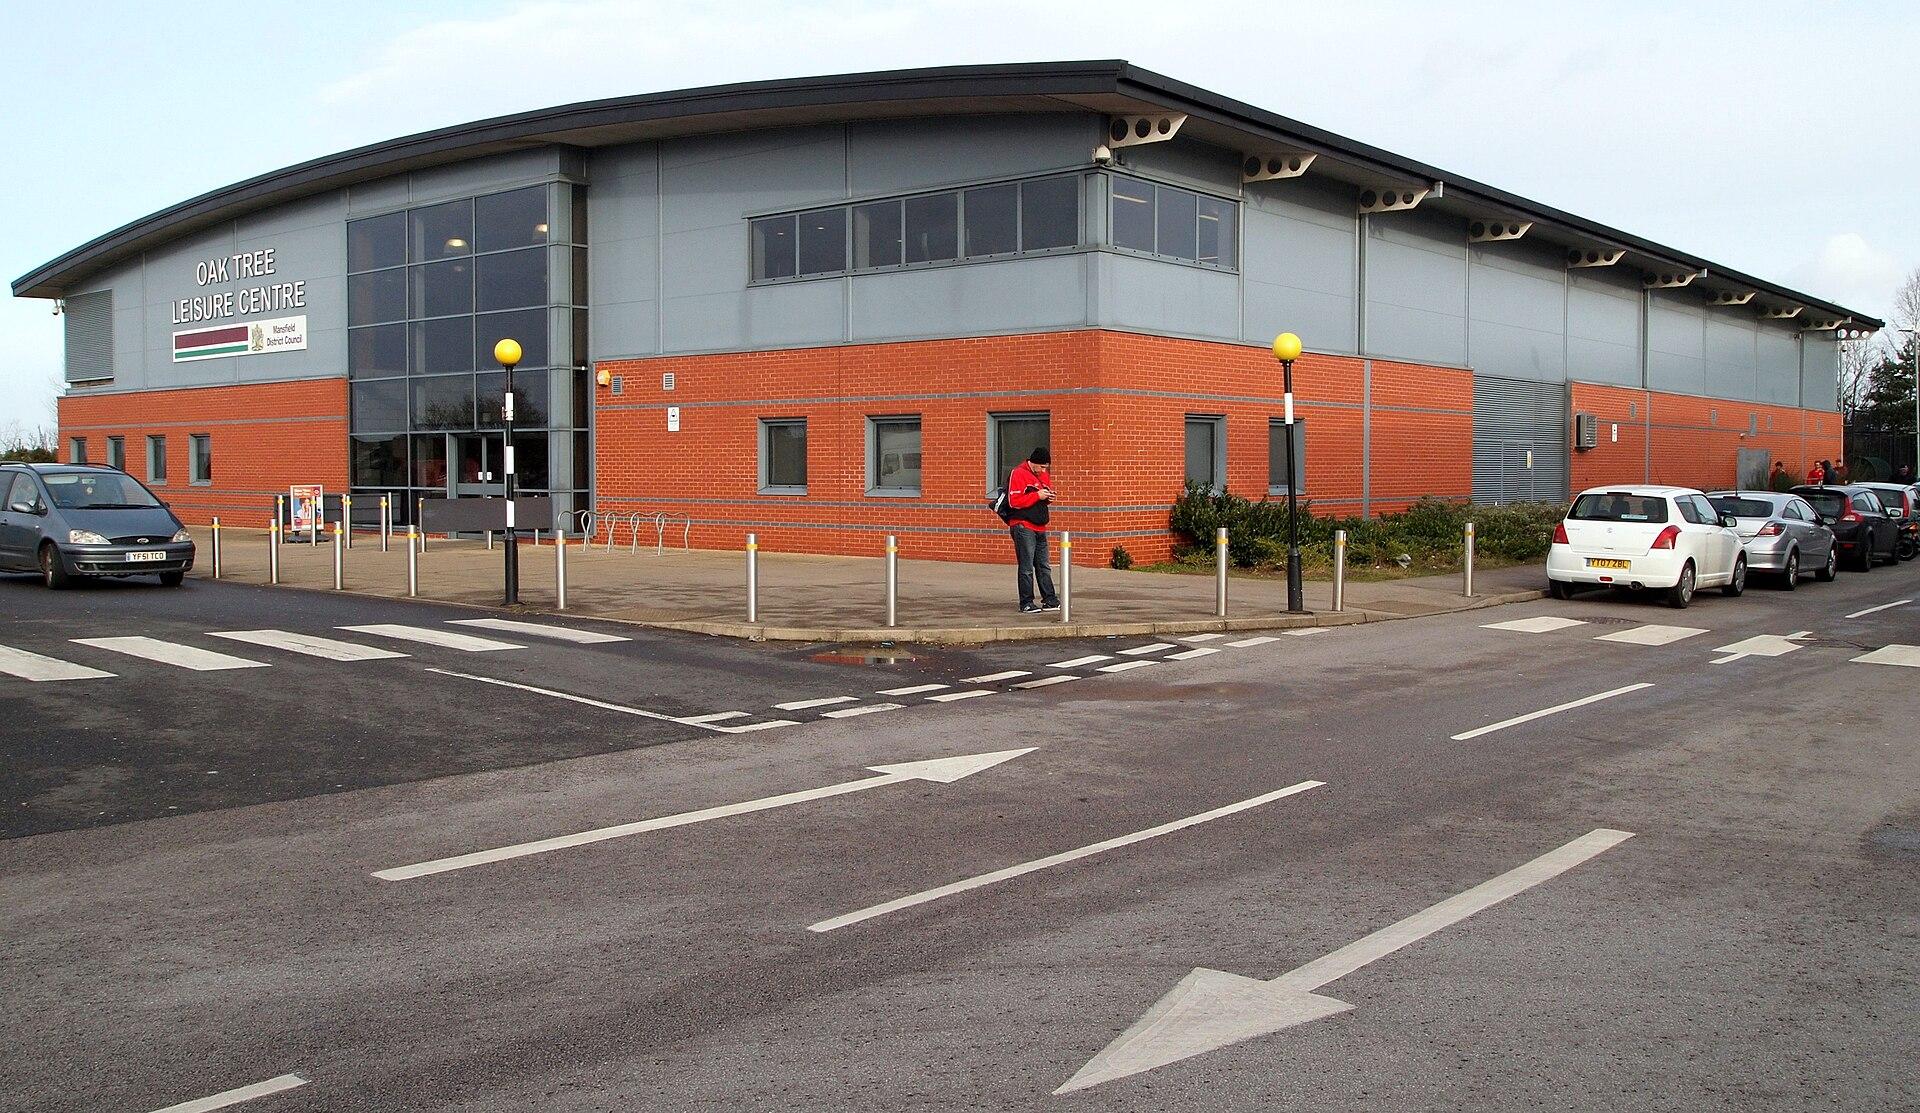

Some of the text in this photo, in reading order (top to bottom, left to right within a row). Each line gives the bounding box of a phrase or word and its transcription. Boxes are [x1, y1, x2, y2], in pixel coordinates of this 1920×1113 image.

[196, 248, 276, 287] OAK TREE
[172, 280, 307, 324] LEISURE CENTRE
[267, 334, 302, 346] District Council
